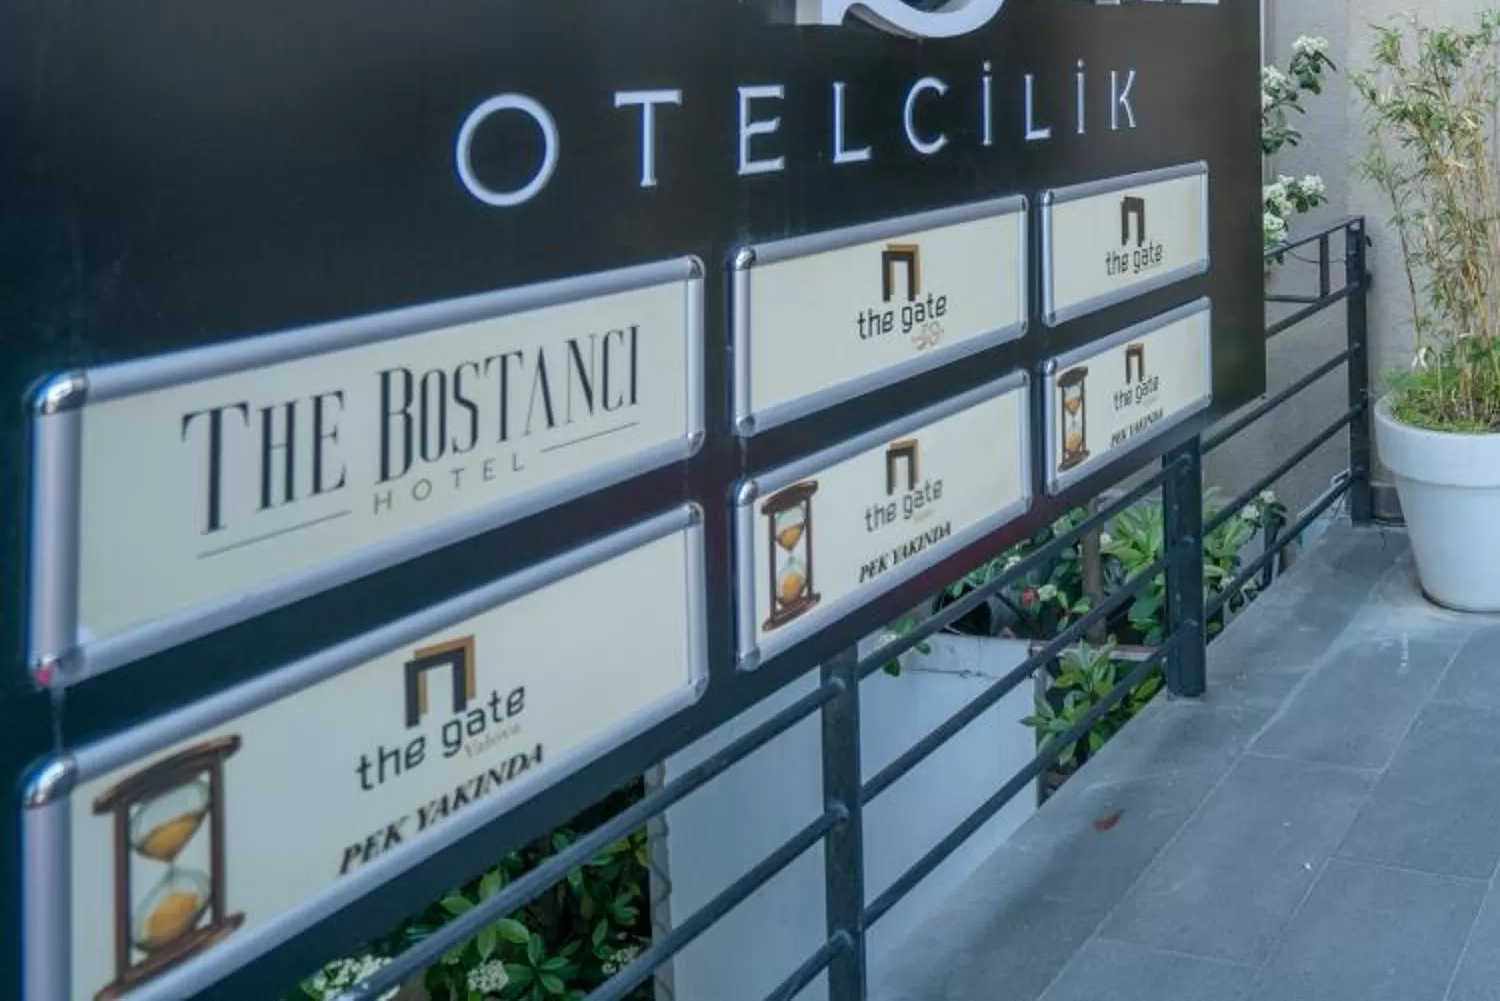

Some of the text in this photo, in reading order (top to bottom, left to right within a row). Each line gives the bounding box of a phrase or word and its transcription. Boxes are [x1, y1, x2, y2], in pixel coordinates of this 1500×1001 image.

[455, 58, 1137, 207] OTELCİLİK
[1105, 240, 1163, 277] the gate
[857, 292, 948, 341] the gate
[180, 324, 642, 535] THE BOSTANCI
[373, 452, 525, 515] HOTEL
[864, 478, 943, 533] the gate
[859, 520, 952, 584] PEK YAKINDA
[355, 686, 526, 792] the gate
[338, 742, 544, 876] PEK YAKINDA
